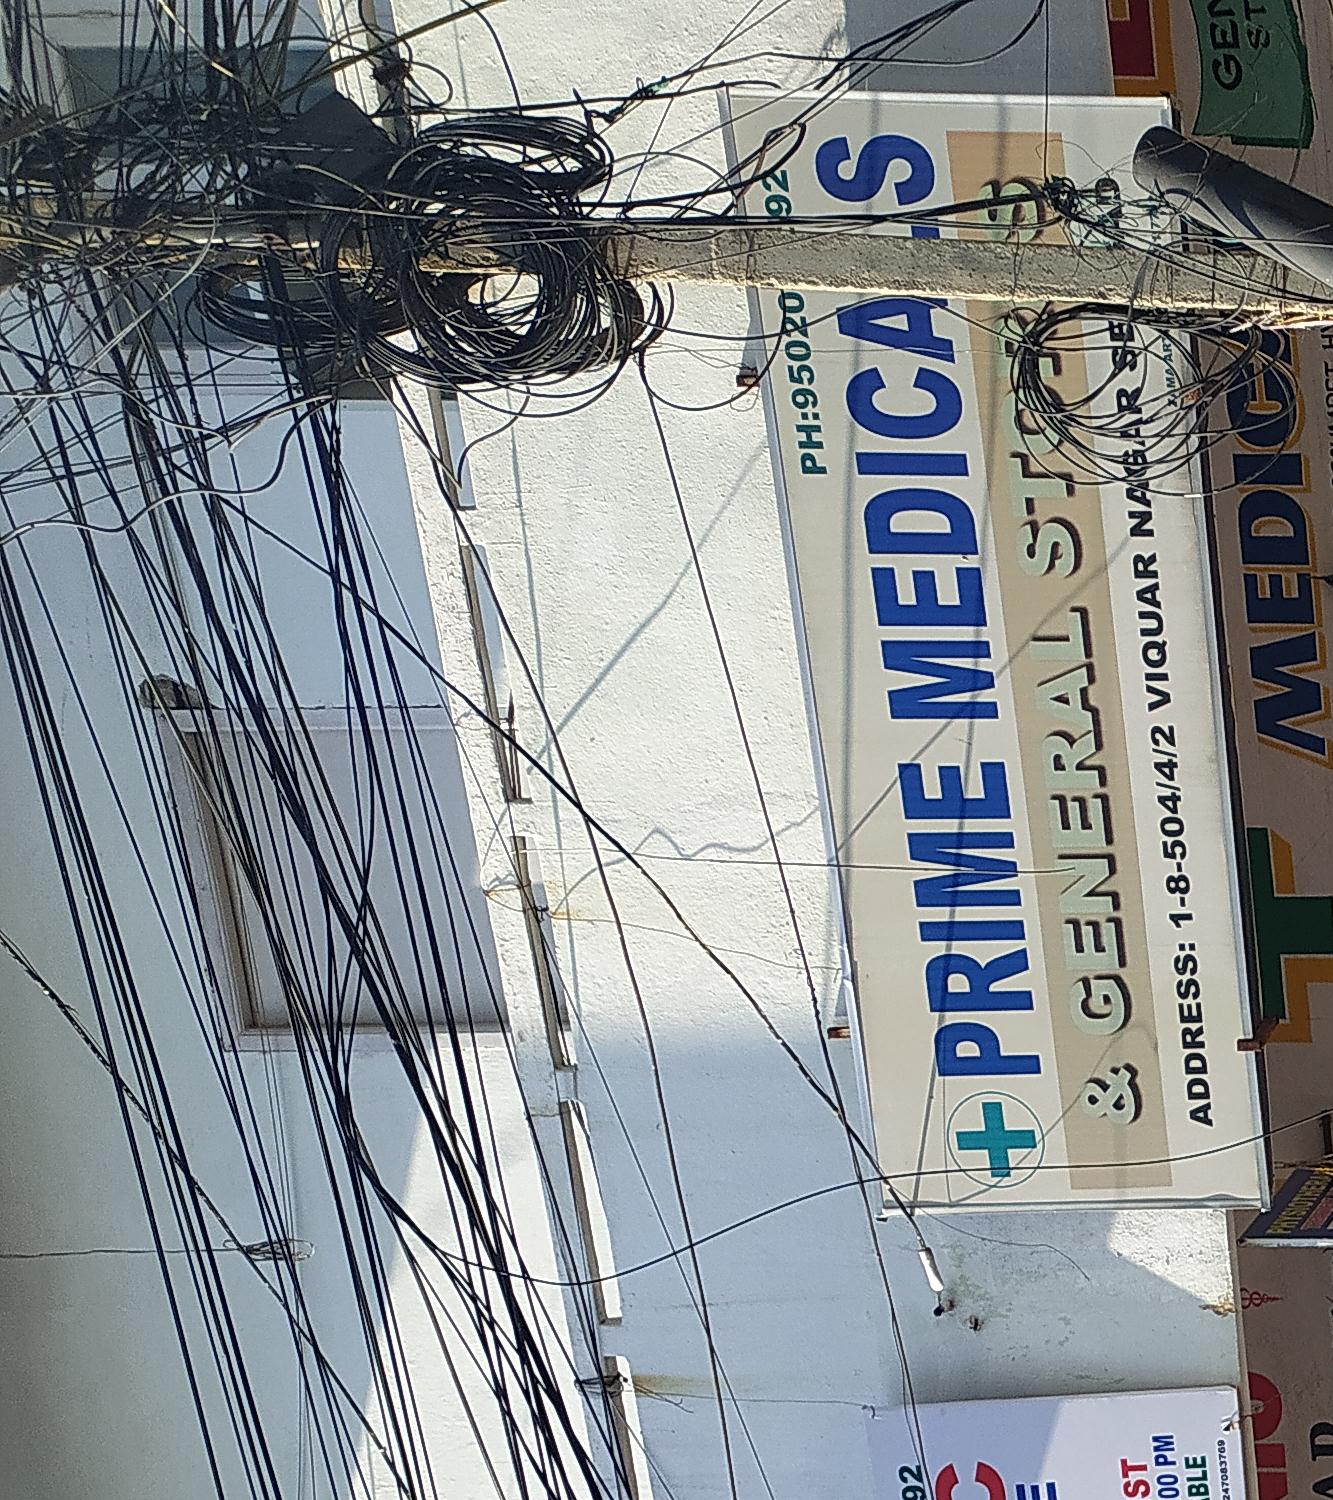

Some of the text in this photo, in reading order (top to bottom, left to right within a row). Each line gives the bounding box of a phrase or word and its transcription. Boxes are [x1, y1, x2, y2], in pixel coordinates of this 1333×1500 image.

[762, 169, 827, 475] PH:9502092
[1114, 388, 1156, 538] NAGAR
[814, 134, 1042, 1077] PRIME MEDICAS
[975, 178, 1141, 1125] & GENERAL STORS
[1131, 551, 1171, 713] VIQUAR
[1150, 724, 1193, 929] 1-8-504/4/2
[1172, 942, 1213, 1127] ADDRESS:
[1152, 1435, 1176, 1467] PM
